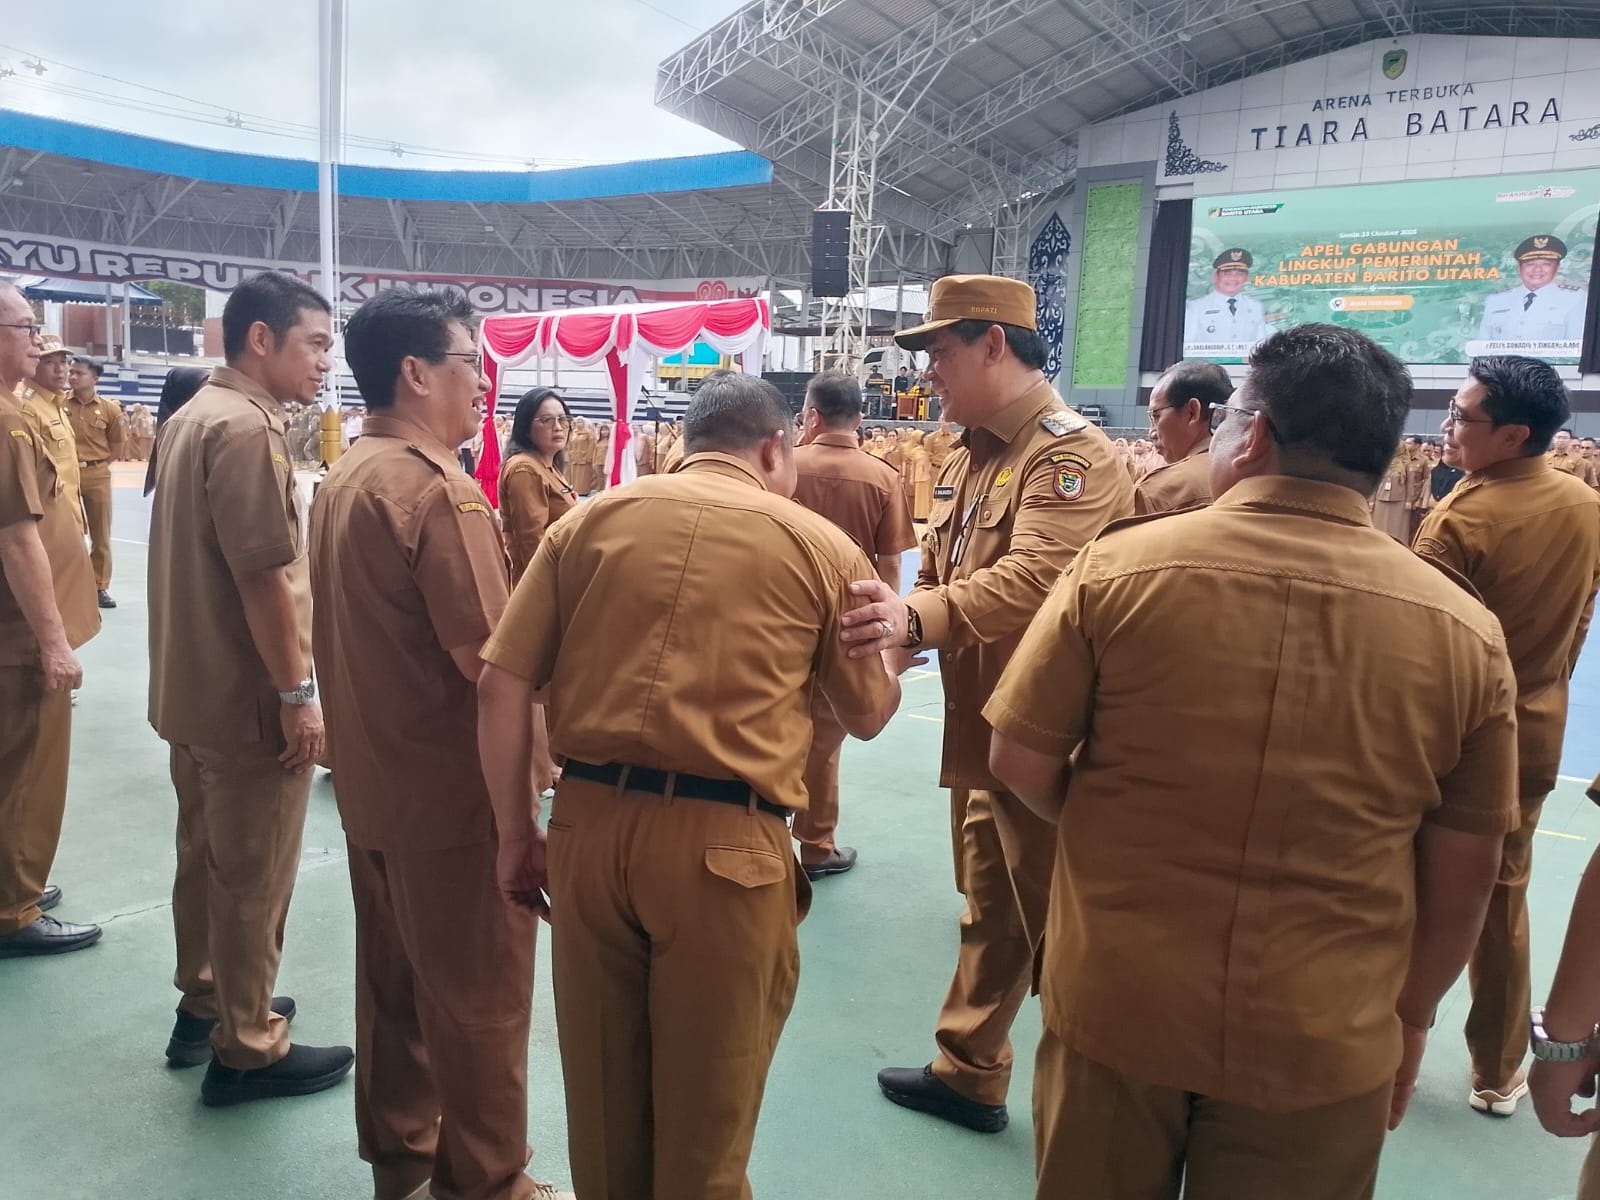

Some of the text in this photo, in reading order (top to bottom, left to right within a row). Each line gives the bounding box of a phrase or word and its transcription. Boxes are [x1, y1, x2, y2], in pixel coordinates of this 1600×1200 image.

[1312, 83, 1475, 112] ARENA TERBUKA
[1250, 97, 1561, 150] TIARA BATARA
[1301, 238, 1459, 257] APEL GABUNGAN
[0, 237, 80, 274] YU
[92, 249, 379, 302] REPUK
[1278, 252, 1481, 272] LINGKUP PEMERINTAH
[1254, 266, 1500, 287] KABUPATEN BARITO UTARA
